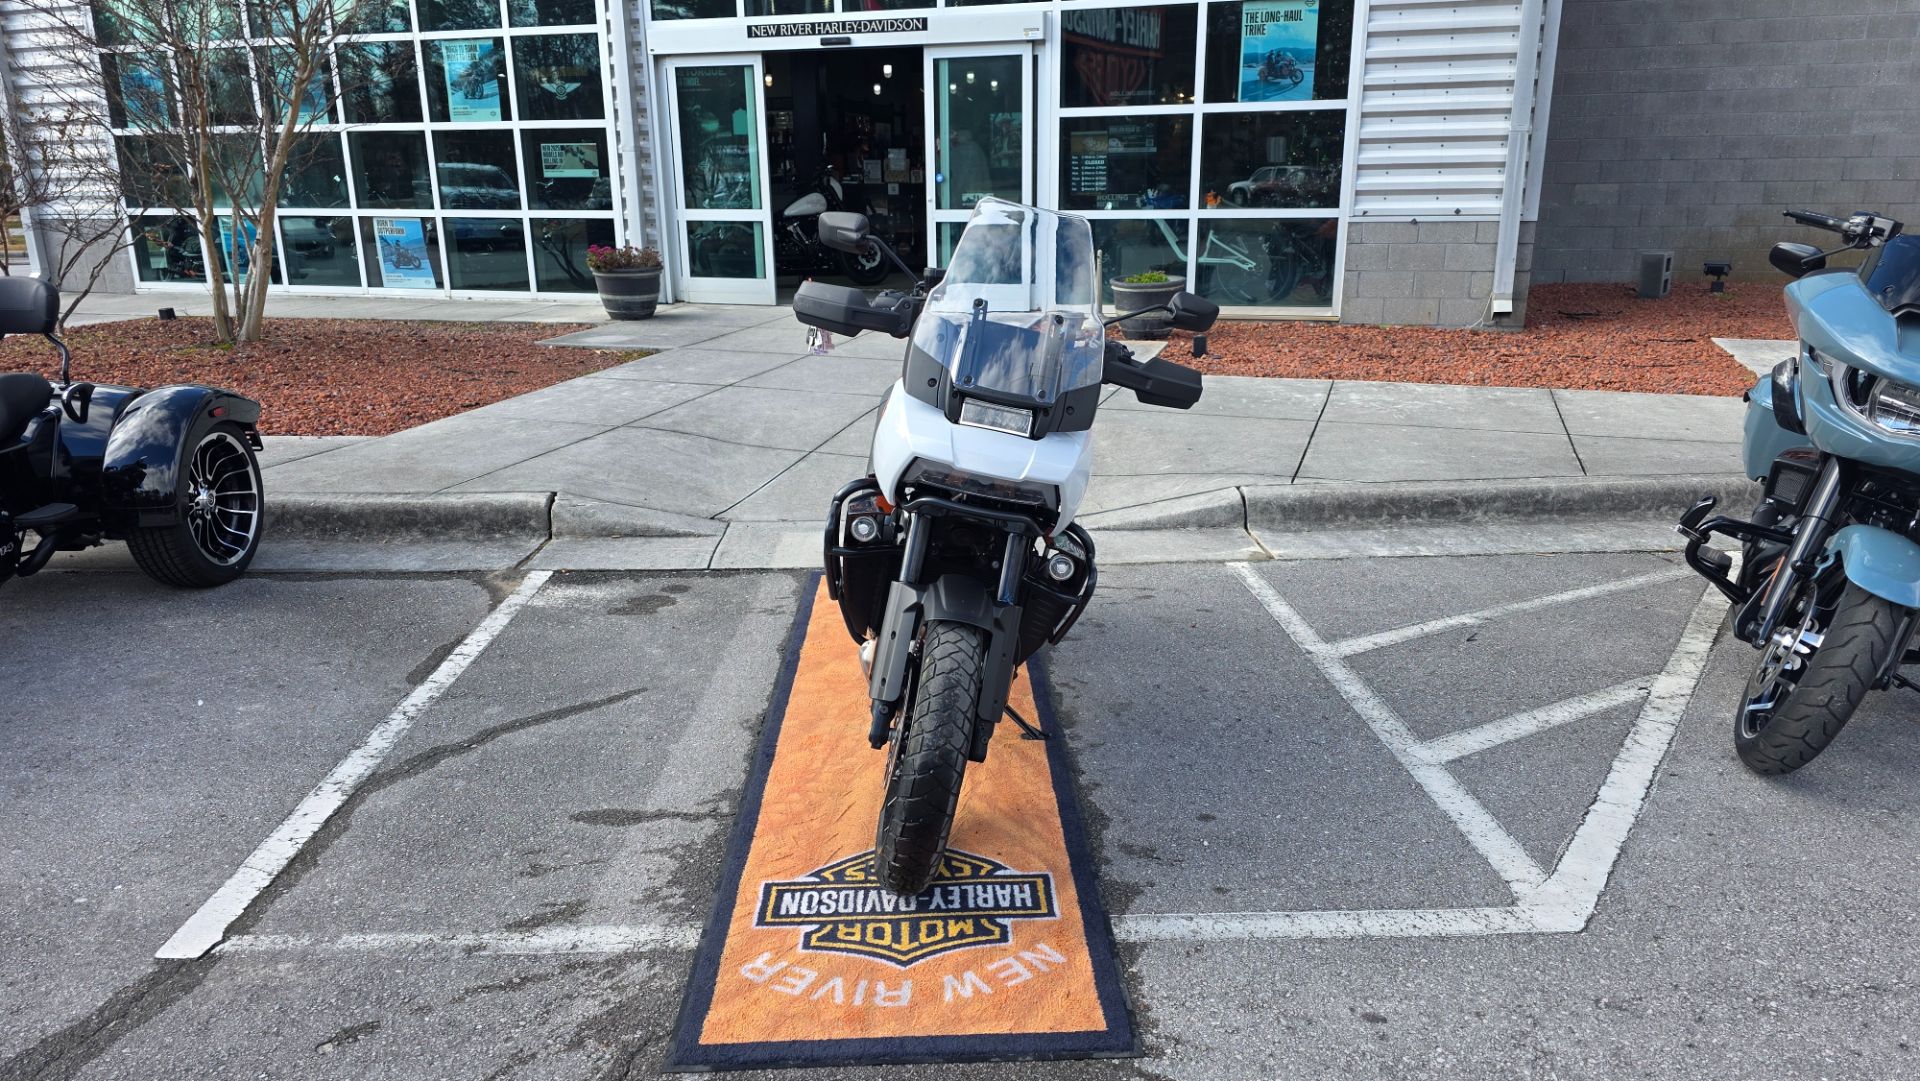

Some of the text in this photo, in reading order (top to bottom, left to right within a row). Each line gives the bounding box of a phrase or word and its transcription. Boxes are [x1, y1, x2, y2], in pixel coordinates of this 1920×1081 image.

[1245, 9, 1303, 24] THE LONG-HAUL
[751, 18, 923, 37] NEW RIVER HARLEY-DAVIDSON
[1244, 24, 1266, 36] TRIKE
[836, 919, 975, 951] MOTOR
[740, 943, 1068, 1008] NEW RIVER
